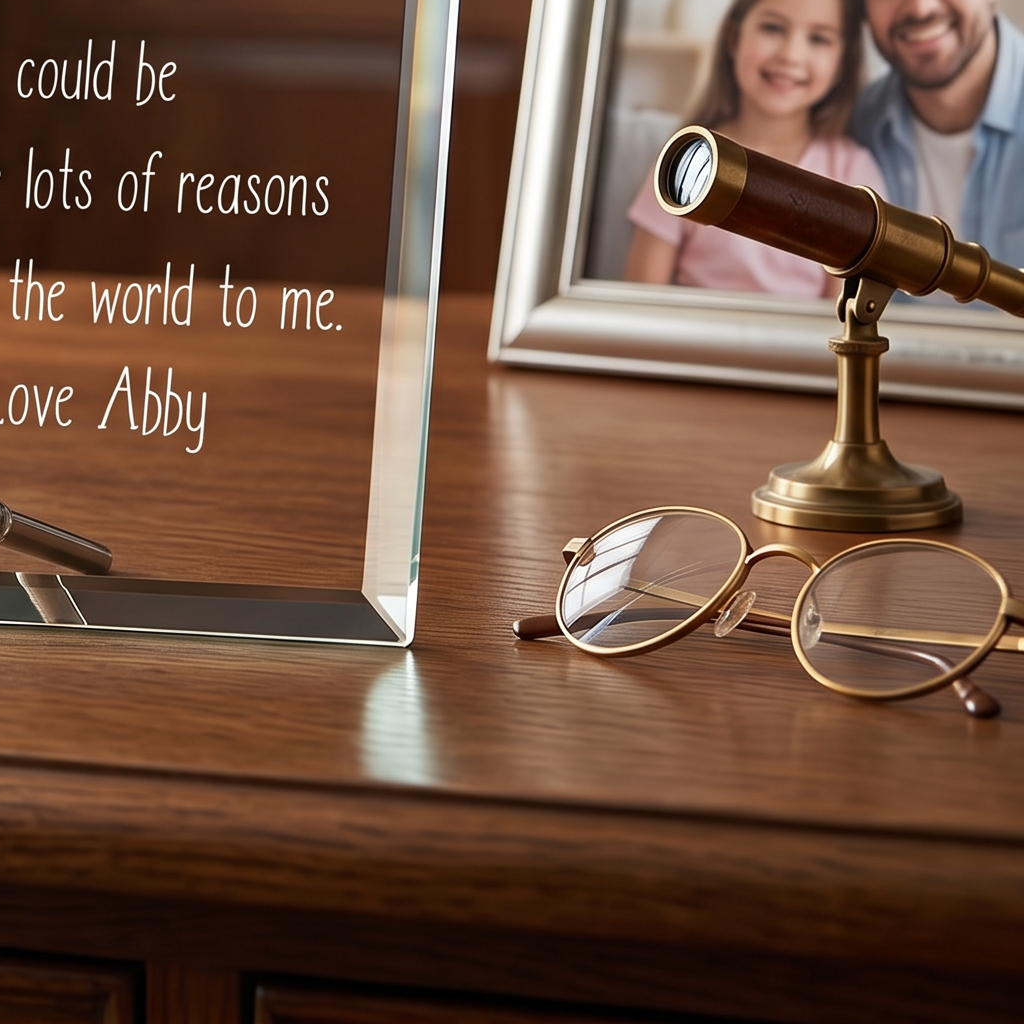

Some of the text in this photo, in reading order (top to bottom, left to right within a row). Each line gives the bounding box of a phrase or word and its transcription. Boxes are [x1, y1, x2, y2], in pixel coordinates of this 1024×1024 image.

[16, 38, 117, 101] could
[135, 39, 178, 107] be
[25, 146, 92, 210] lots
[117, 150, 163, 213] of
[177, 171, 330, 217] reasons
[9, 258, 66, 322] the
[90, 261, 195, 327] world
[218, 263, 257, 328] to
[280, 286, 343, 331] me.
[97, 365, 207, 454] Abby
